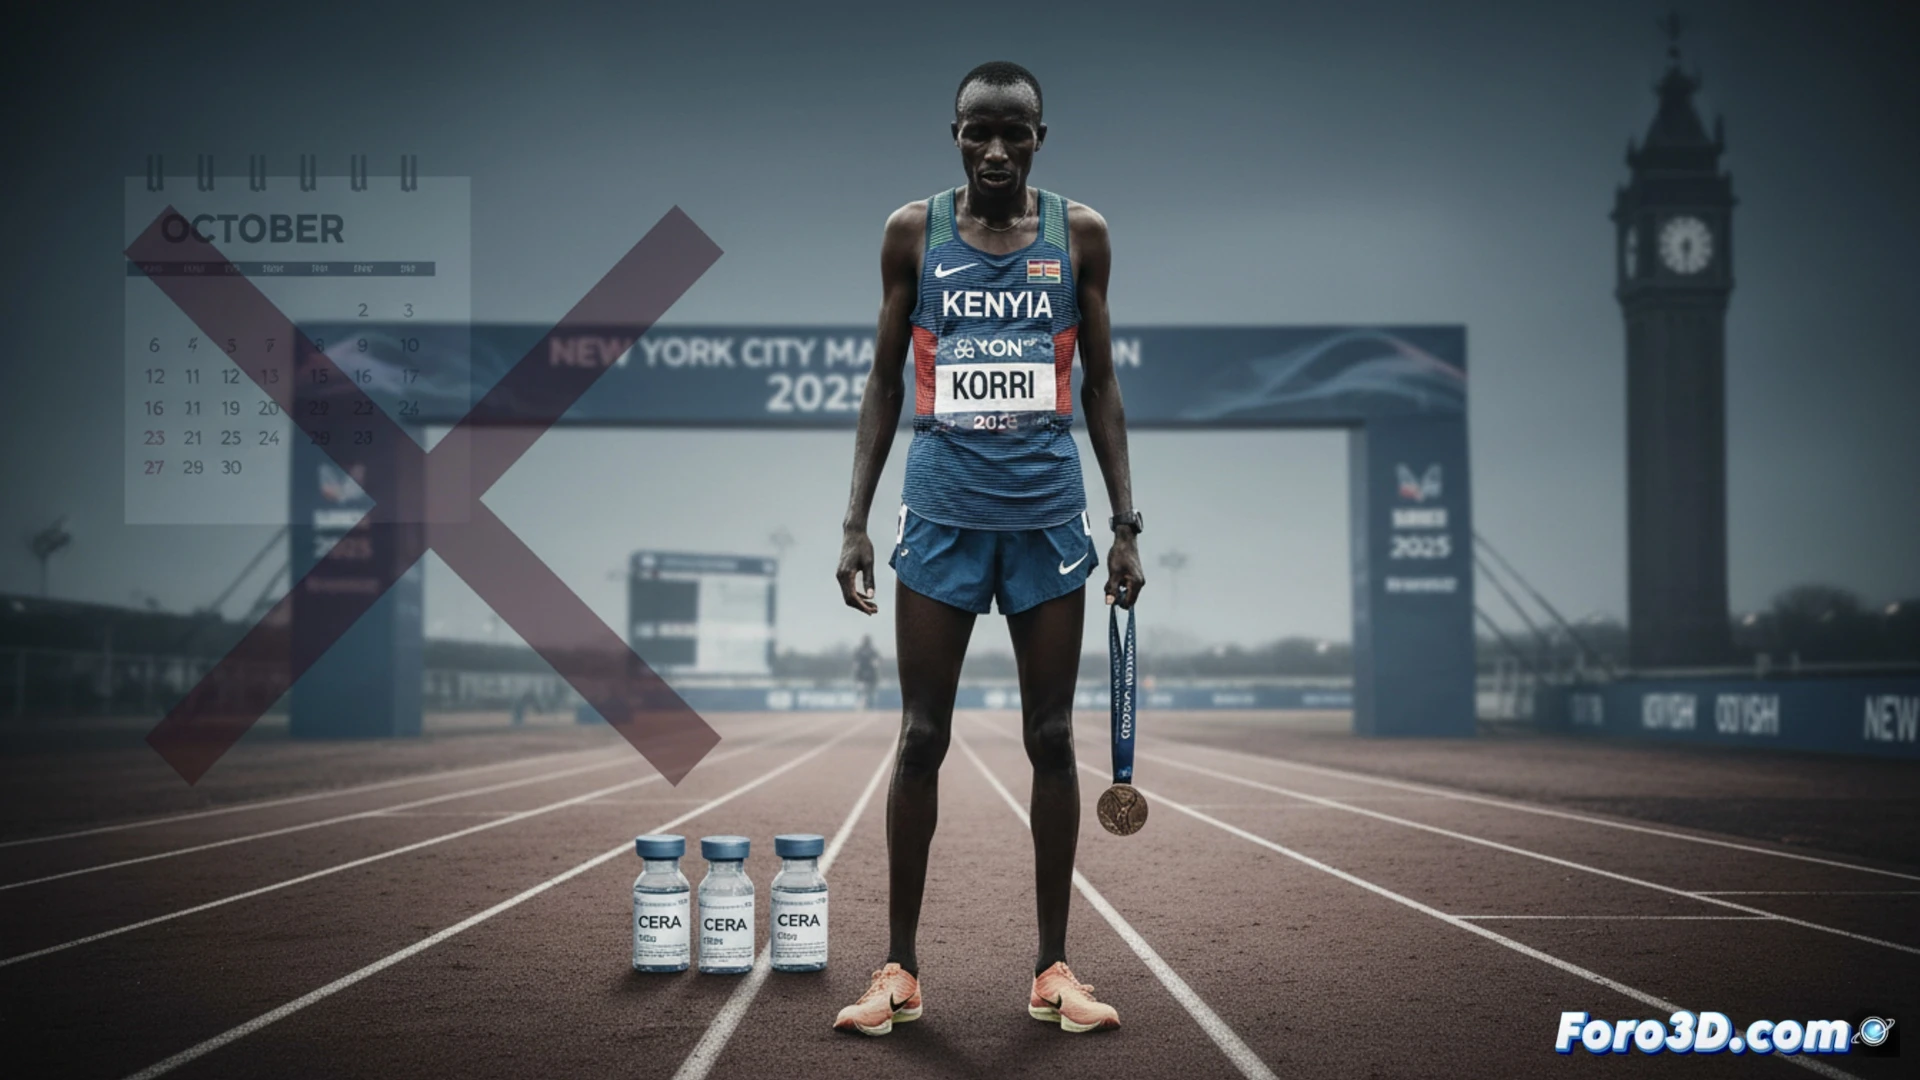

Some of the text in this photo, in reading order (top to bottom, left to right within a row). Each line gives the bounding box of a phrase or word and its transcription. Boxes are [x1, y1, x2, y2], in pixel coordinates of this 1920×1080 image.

[942, 290, 1053, 318] KENYIA
[549, 337, 634, 369] NEW
[639, 337, 737, 369] YORK
[740, 337, 816, 368] CITY
[952, 370, 1034, 400] KORRI
[1390, 534, 1451, 560] 2025
[638, 915, 682, 929] CERA
[703, 918, 748, 932] CERA
[777, 913, 820, 928] CERA
